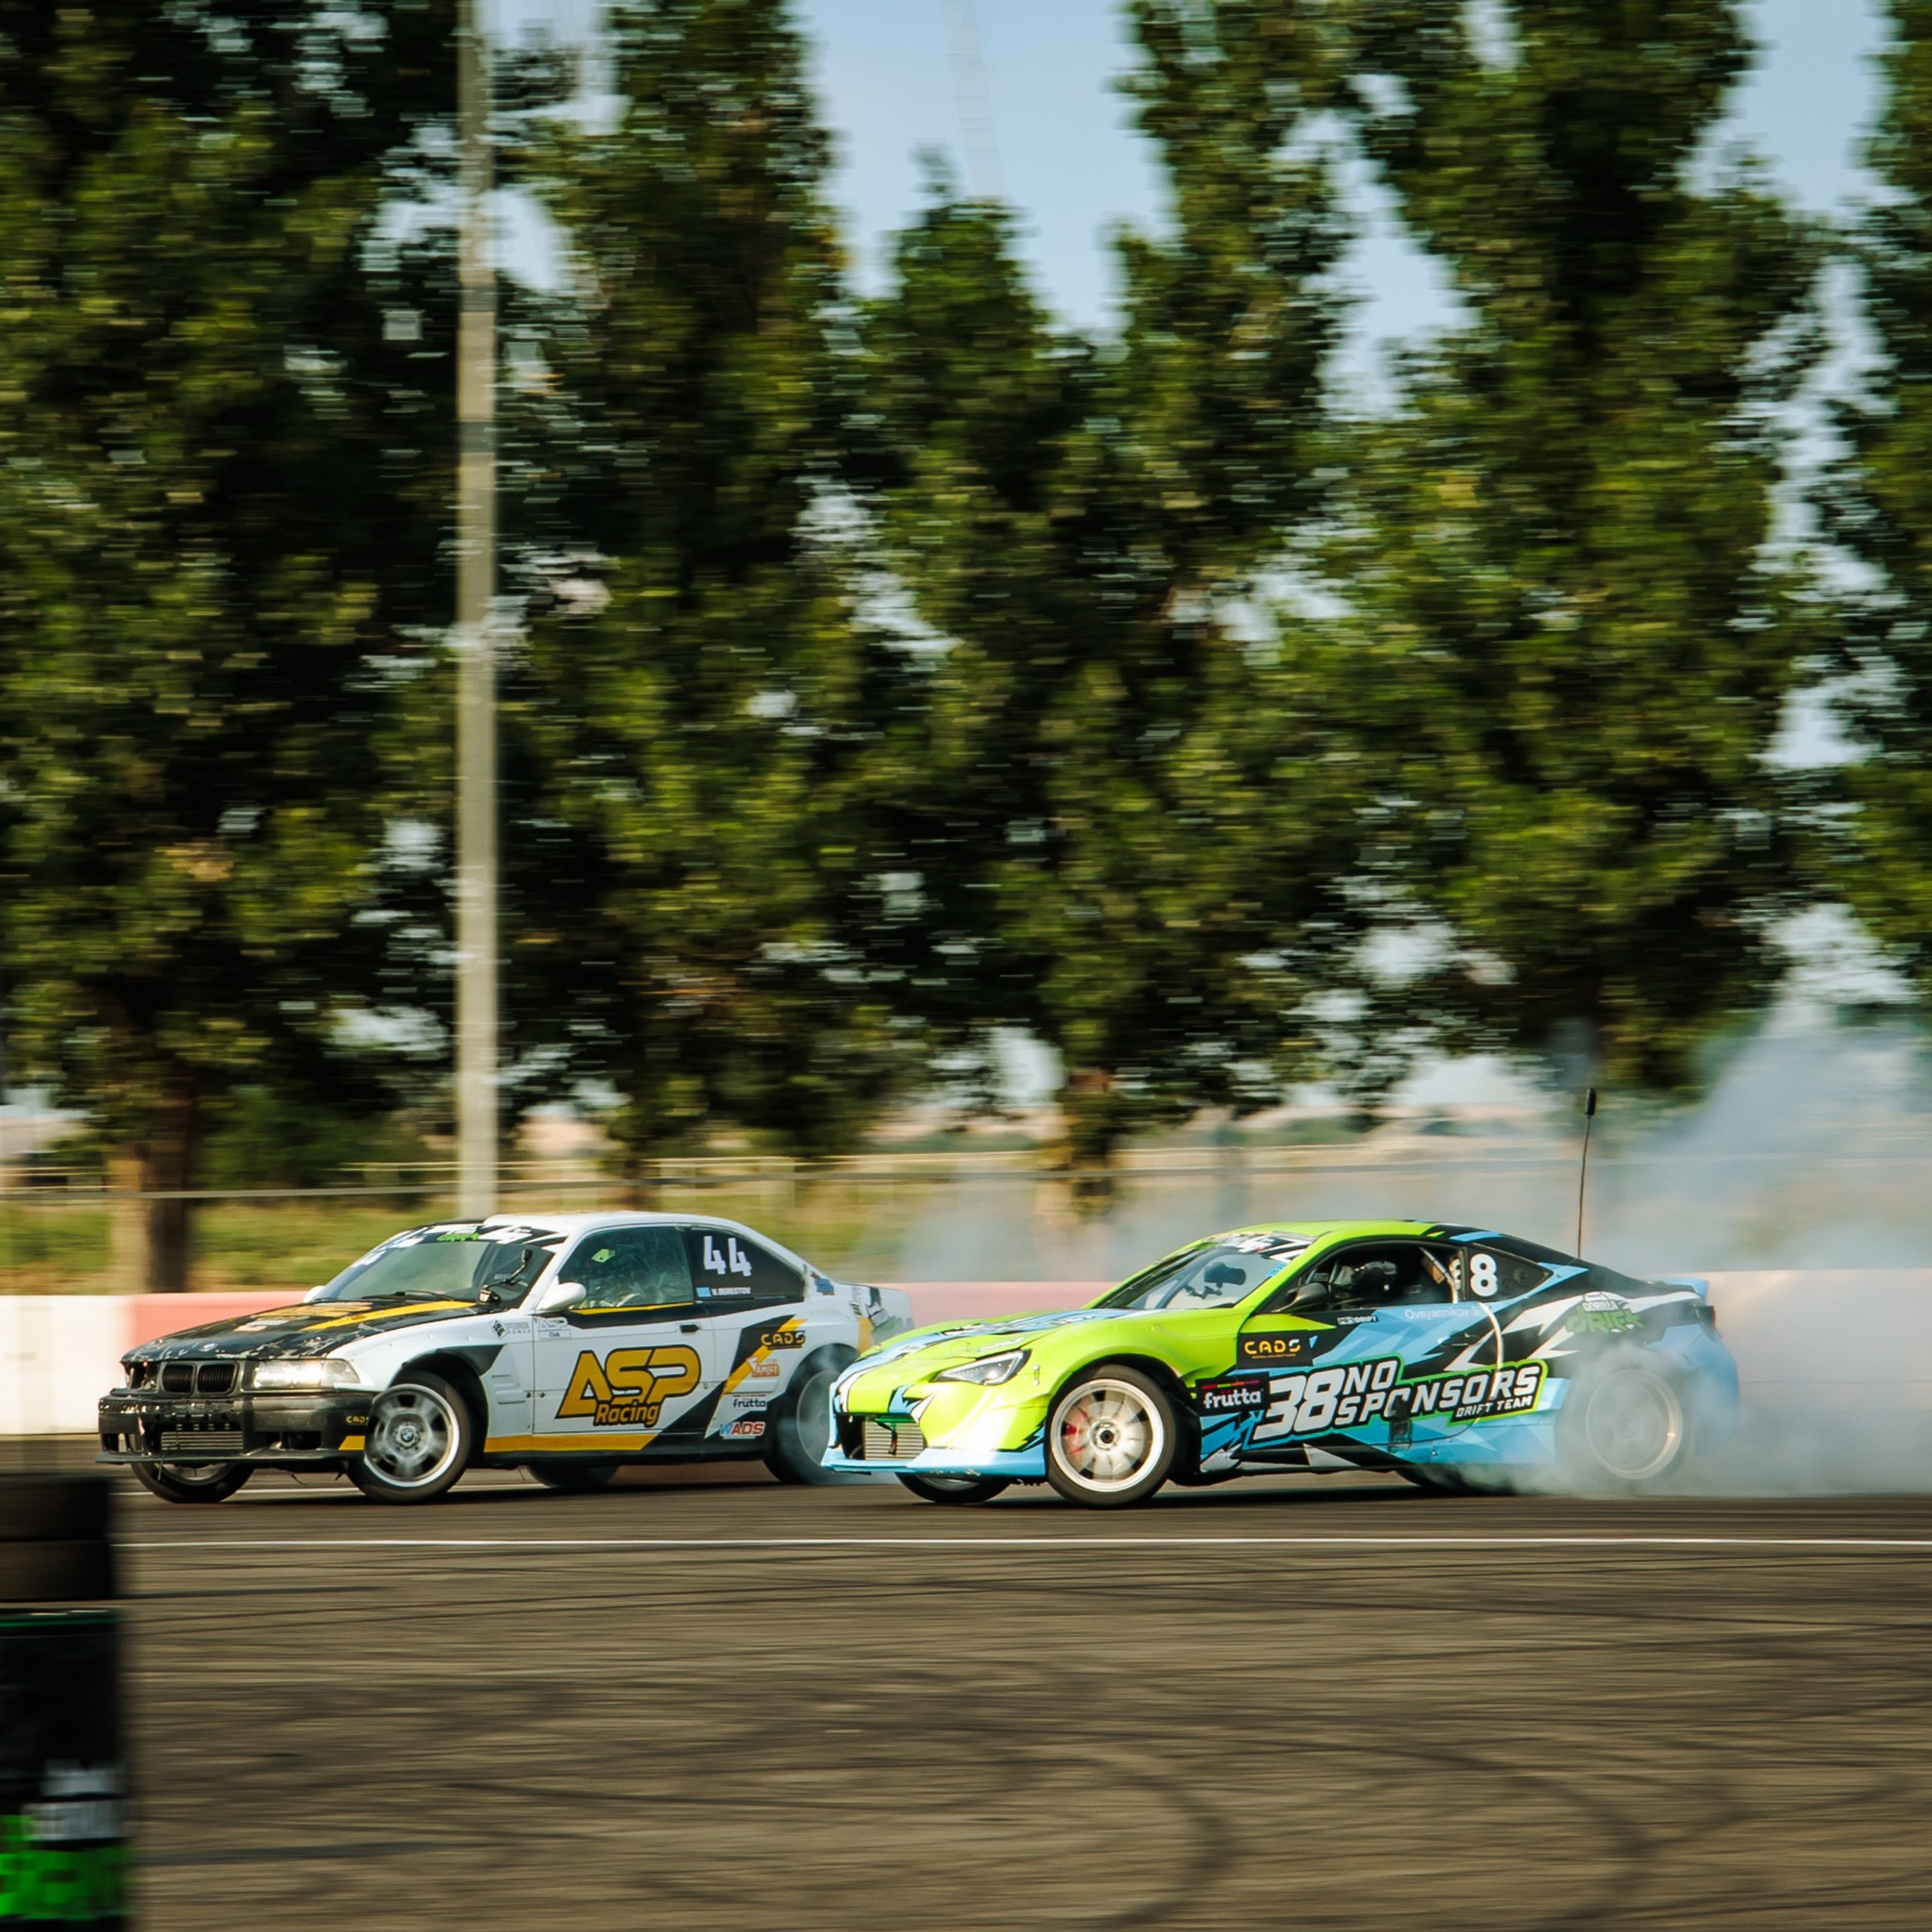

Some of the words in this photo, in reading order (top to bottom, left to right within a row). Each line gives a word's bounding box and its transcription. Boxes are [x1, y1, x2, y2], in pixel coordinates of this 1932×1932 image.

[703, 1235, 752, 1277] 44
[1470, 1254, 1497, 1297] 8
[761, 1331, 805, 1347] CADS
[1244, 1339, 1300, 1355] CADS
[554, 1344, 701, 1419] ASP
[1334, 1366, 1540, 1426] SPONSORS
[1343, 1360, 1398, 1396] NO
[593, 1398, 661, 1428] Racing
[1253, 1368, 1345, 1440] 38
[1456, 1402, 1494, 1417] DRIFT
[1497, 1395, 1533, 1411] TEAM
